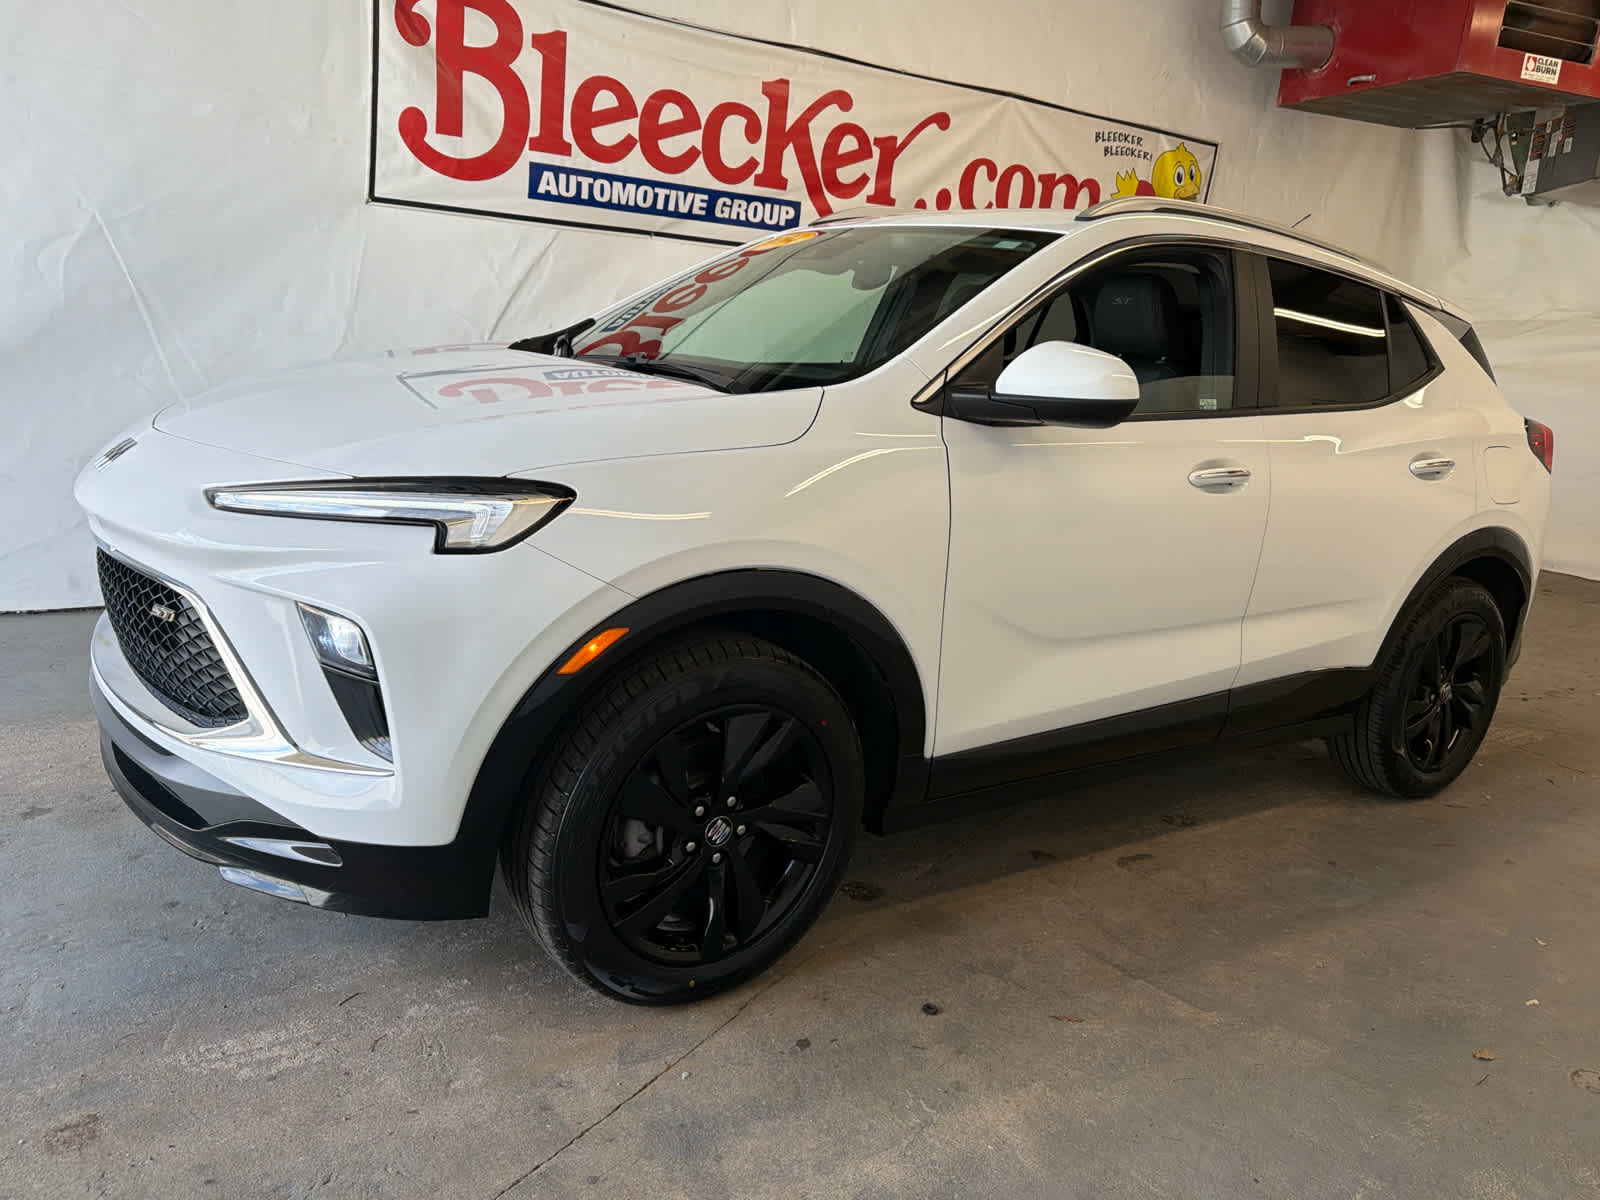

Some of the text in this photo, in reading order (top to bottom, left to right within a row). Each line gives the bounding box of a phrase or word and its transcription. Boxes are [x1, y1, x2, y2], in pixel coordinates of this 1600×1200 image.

[1535, 65, 1557, 76] BURN
[1537, 57, 1559, 68] CLEAN
[394, 0, 951, 217] Bleecker
[1094, 131, 1144, 147] BLEECKER
[537, 170, 796, 227] AUTOMOTIVE GROUP
